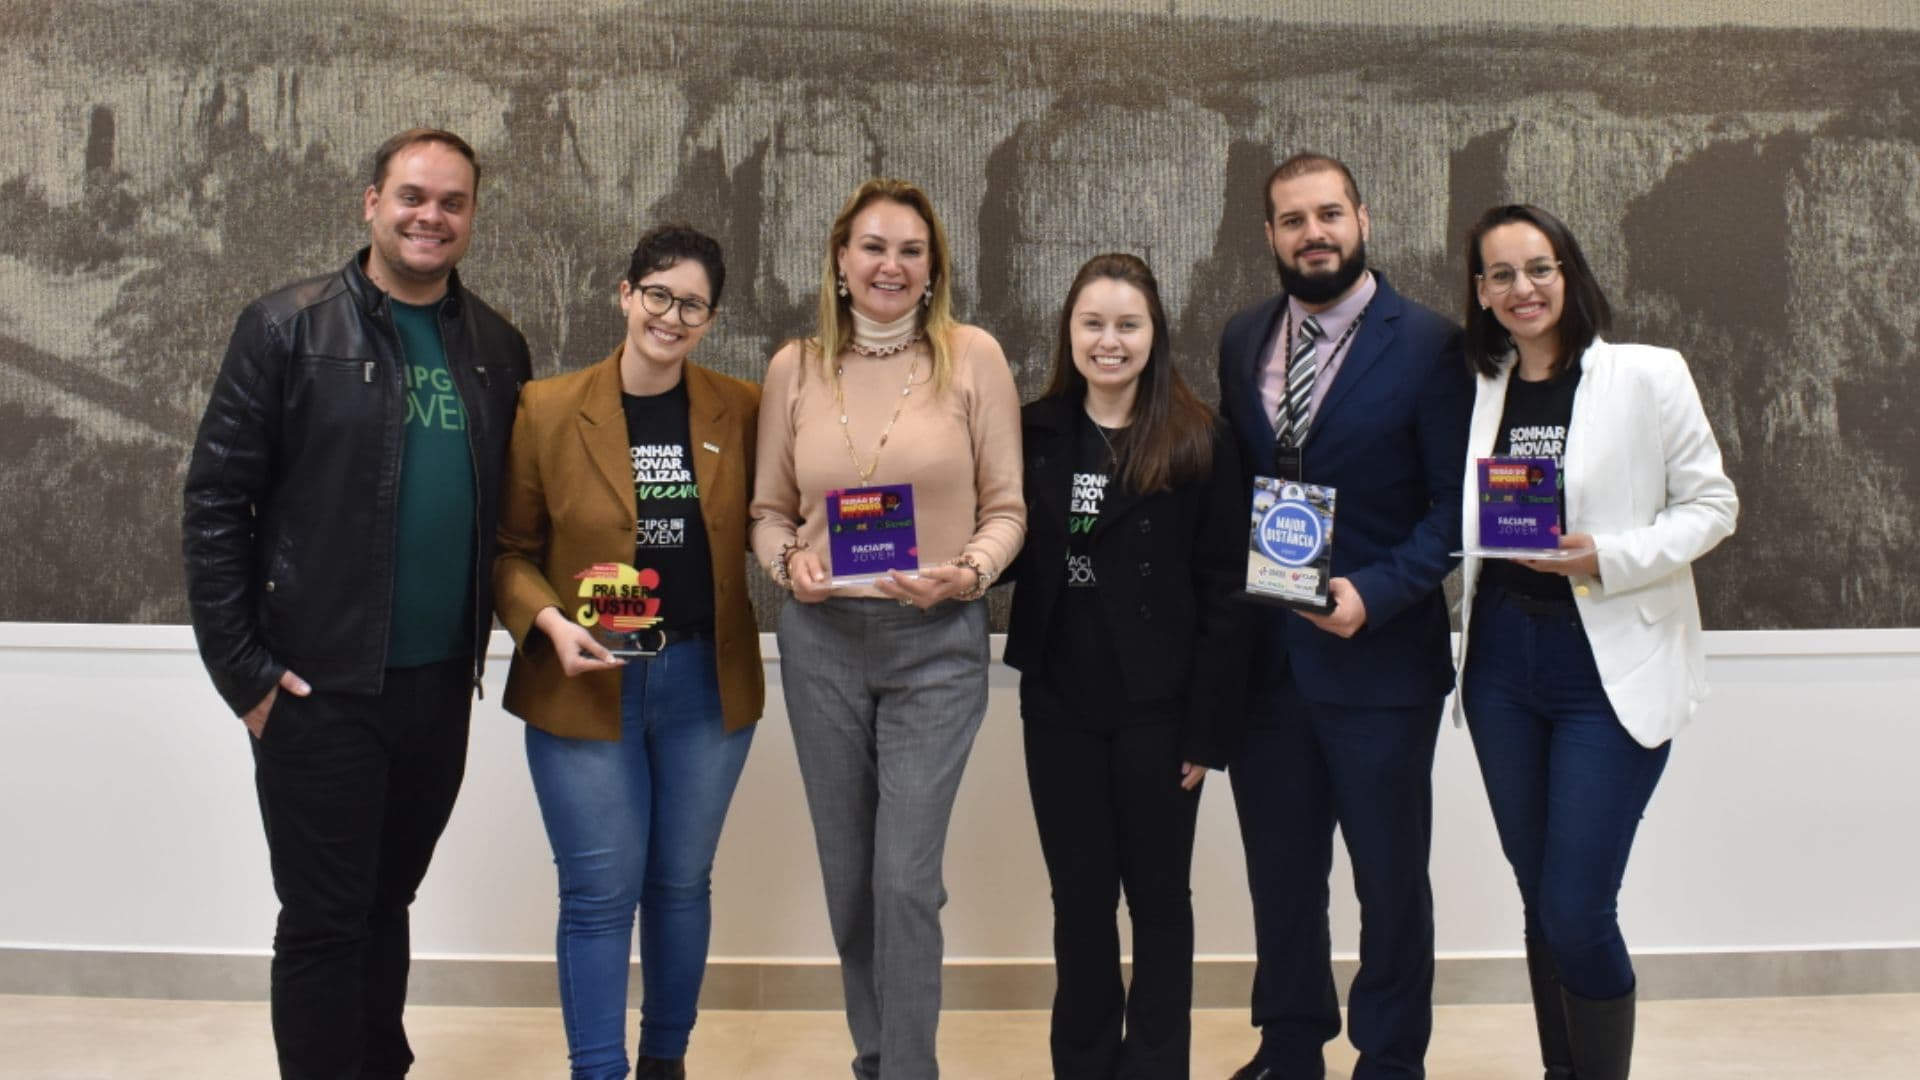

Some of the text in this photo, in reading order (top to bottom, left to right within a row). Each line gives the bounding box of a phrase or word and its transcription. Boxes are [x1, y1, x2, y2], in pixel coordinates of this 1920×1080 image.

[405, 364, 453, 392] IPG
[1510, 426, 1565, 441] SONHAR
[631, 445, 684, 458] ONHAR
[1510, 440, 1563, 456] INOVAR
[633, 457, 682, 470] NOVAR
[635, 470, 692, 482] ALIZAR
[1073, 473, 1109, 487] SONH
[1070, 500, 1099, 514] EAL
[637, 519, 669, 530] CIPG
[1276, 516, 1306, 532] MAIOR
[637, 531, 684, 544] OVEM
[1267, 528, 1314, 548] DISTÂNCIA
[1068, 556, 1091, 568] ACI
[593, 584, 650, 599] PRA SER
[584, 598, 646, 619] JUSTO
